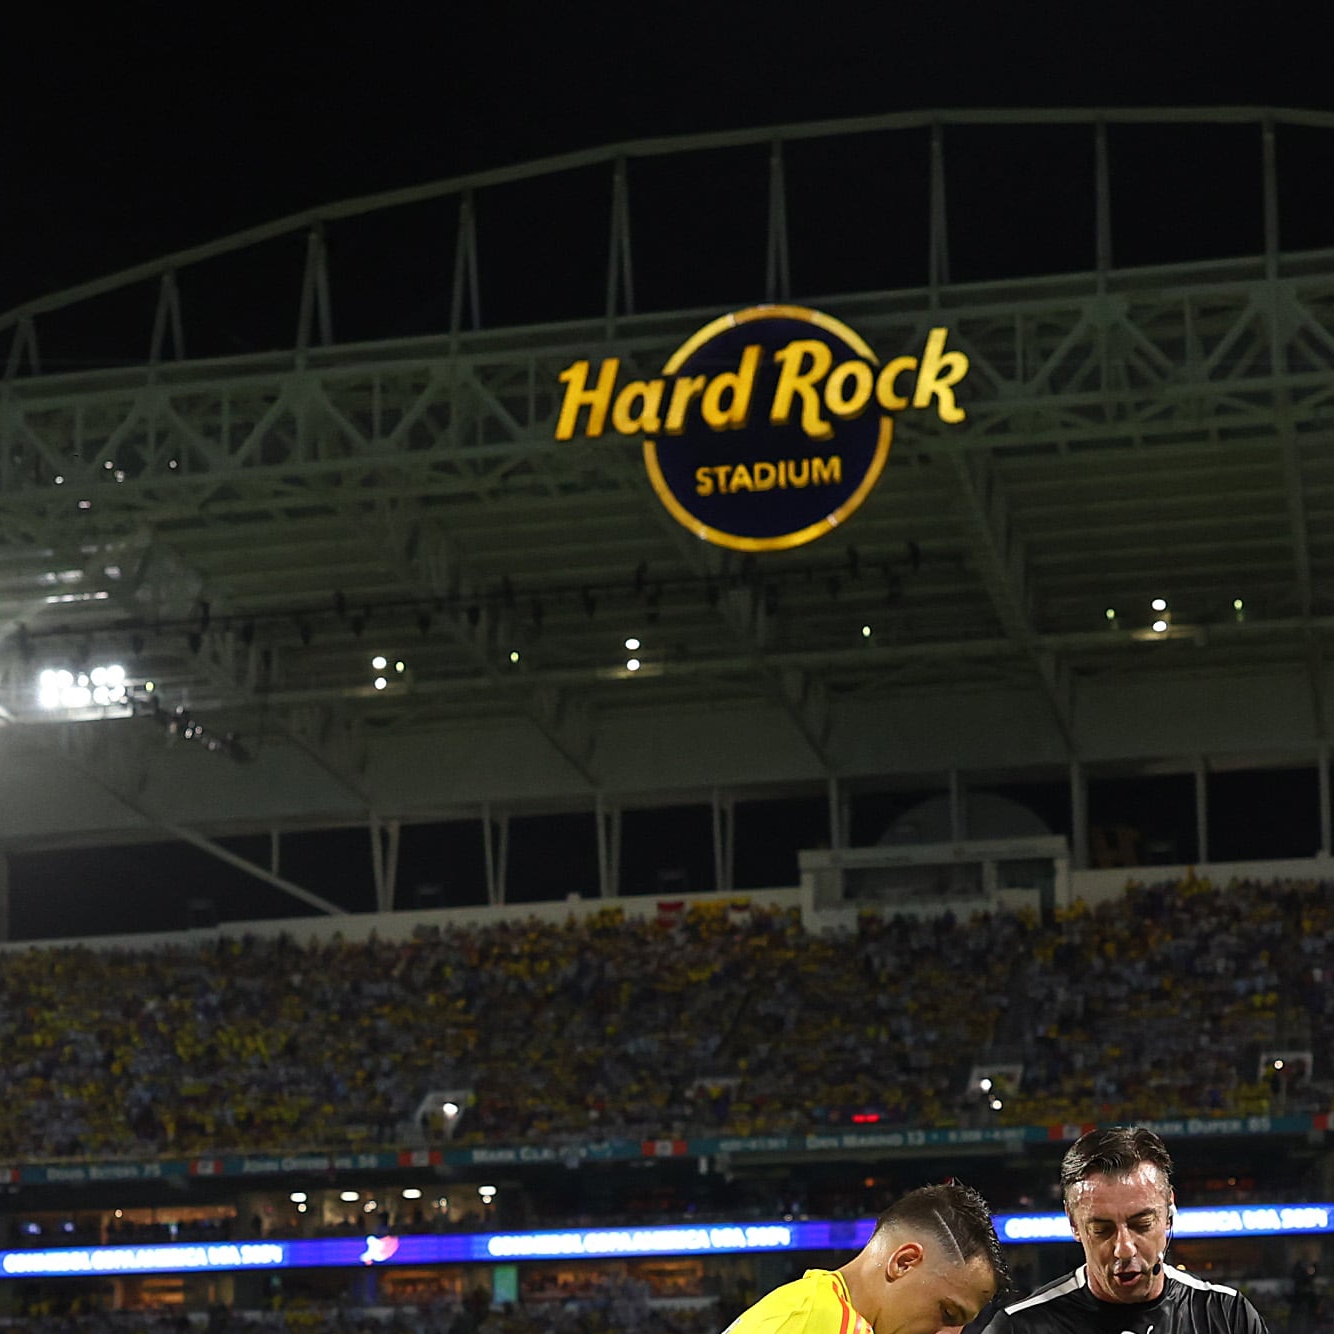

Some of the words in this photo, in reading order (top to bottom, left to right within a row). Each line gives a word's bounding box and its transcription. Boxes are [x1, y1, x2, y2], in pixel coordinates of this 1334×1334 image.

[555, 344, 763, 440] Hard
[770, 327, 969, 440] Rock
[695, 455, 842, 496] STADIUM
